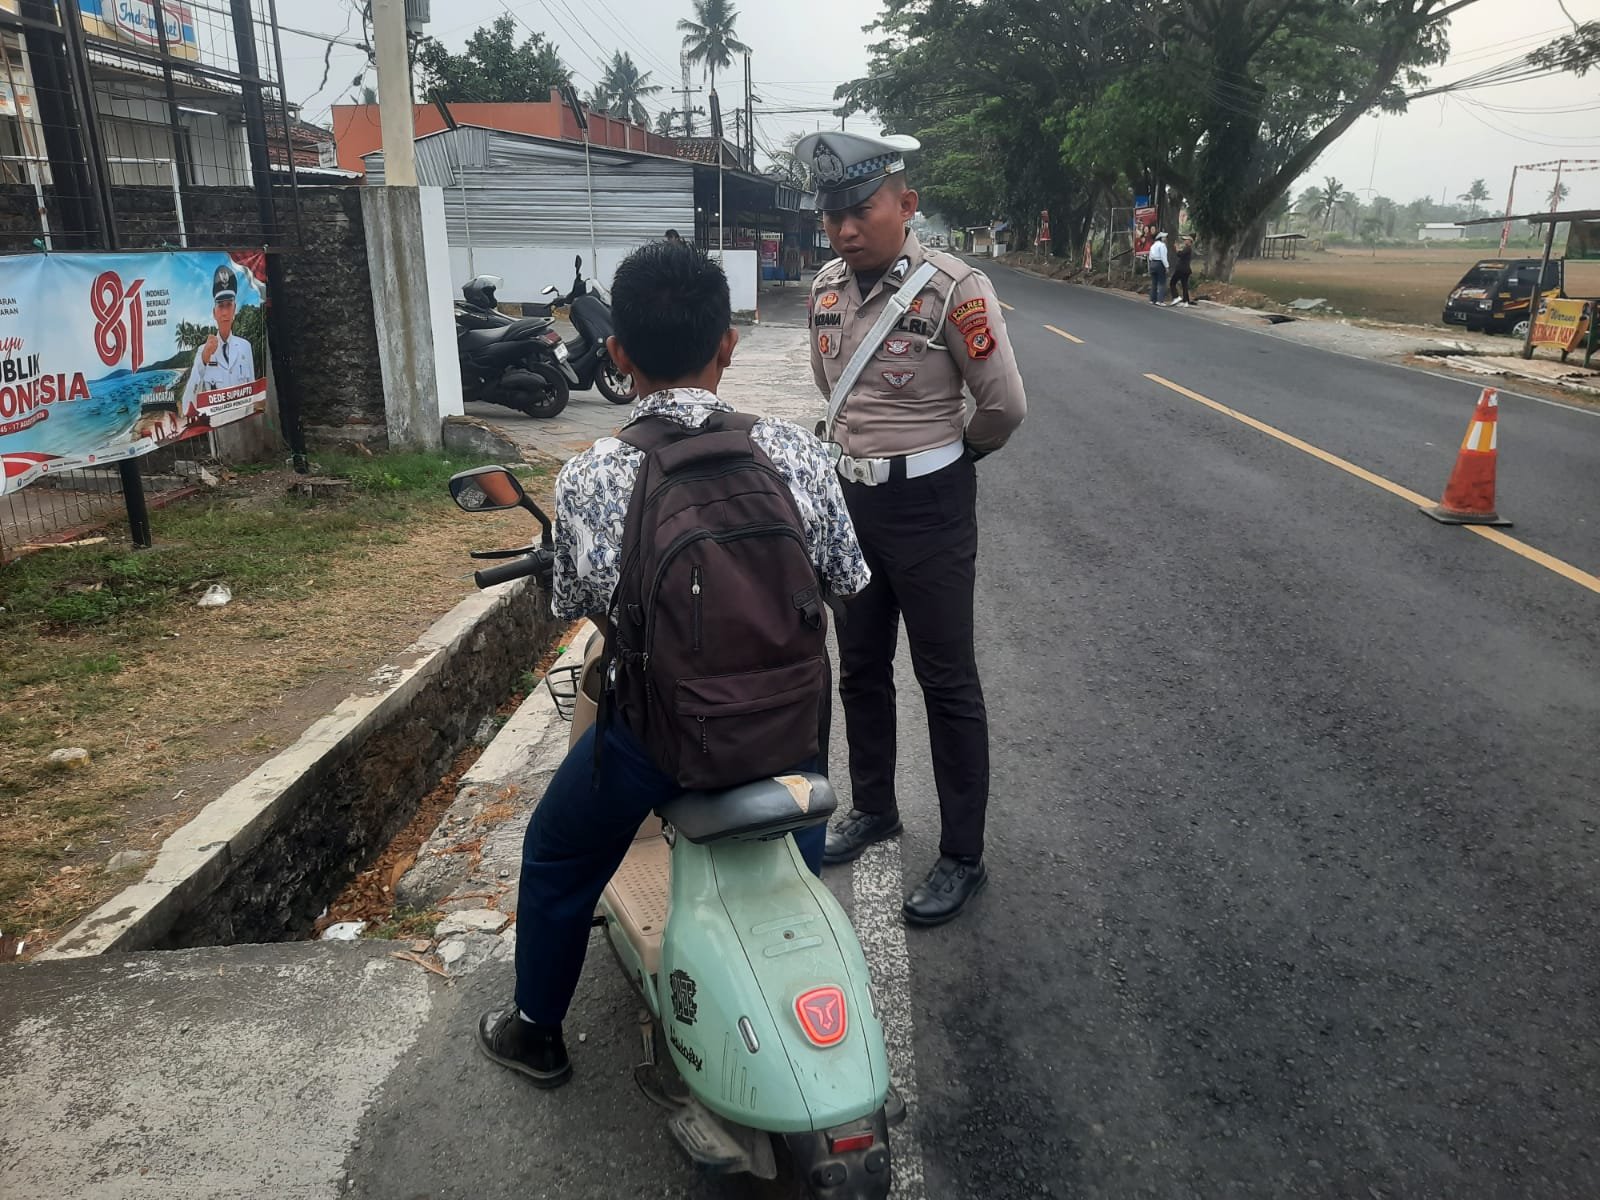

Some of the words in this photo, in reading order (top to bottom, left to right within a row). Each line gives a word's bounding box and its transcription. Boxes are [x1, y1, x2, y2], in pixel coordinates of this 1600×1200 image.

[119, 2, 178, 37] Indomet
[952, 300, 984, 321] POLRES
[90, 270, 145, 374] 81
[896, 317, 927, 335] LRI
[208, 393, 226, 404] DEDE
